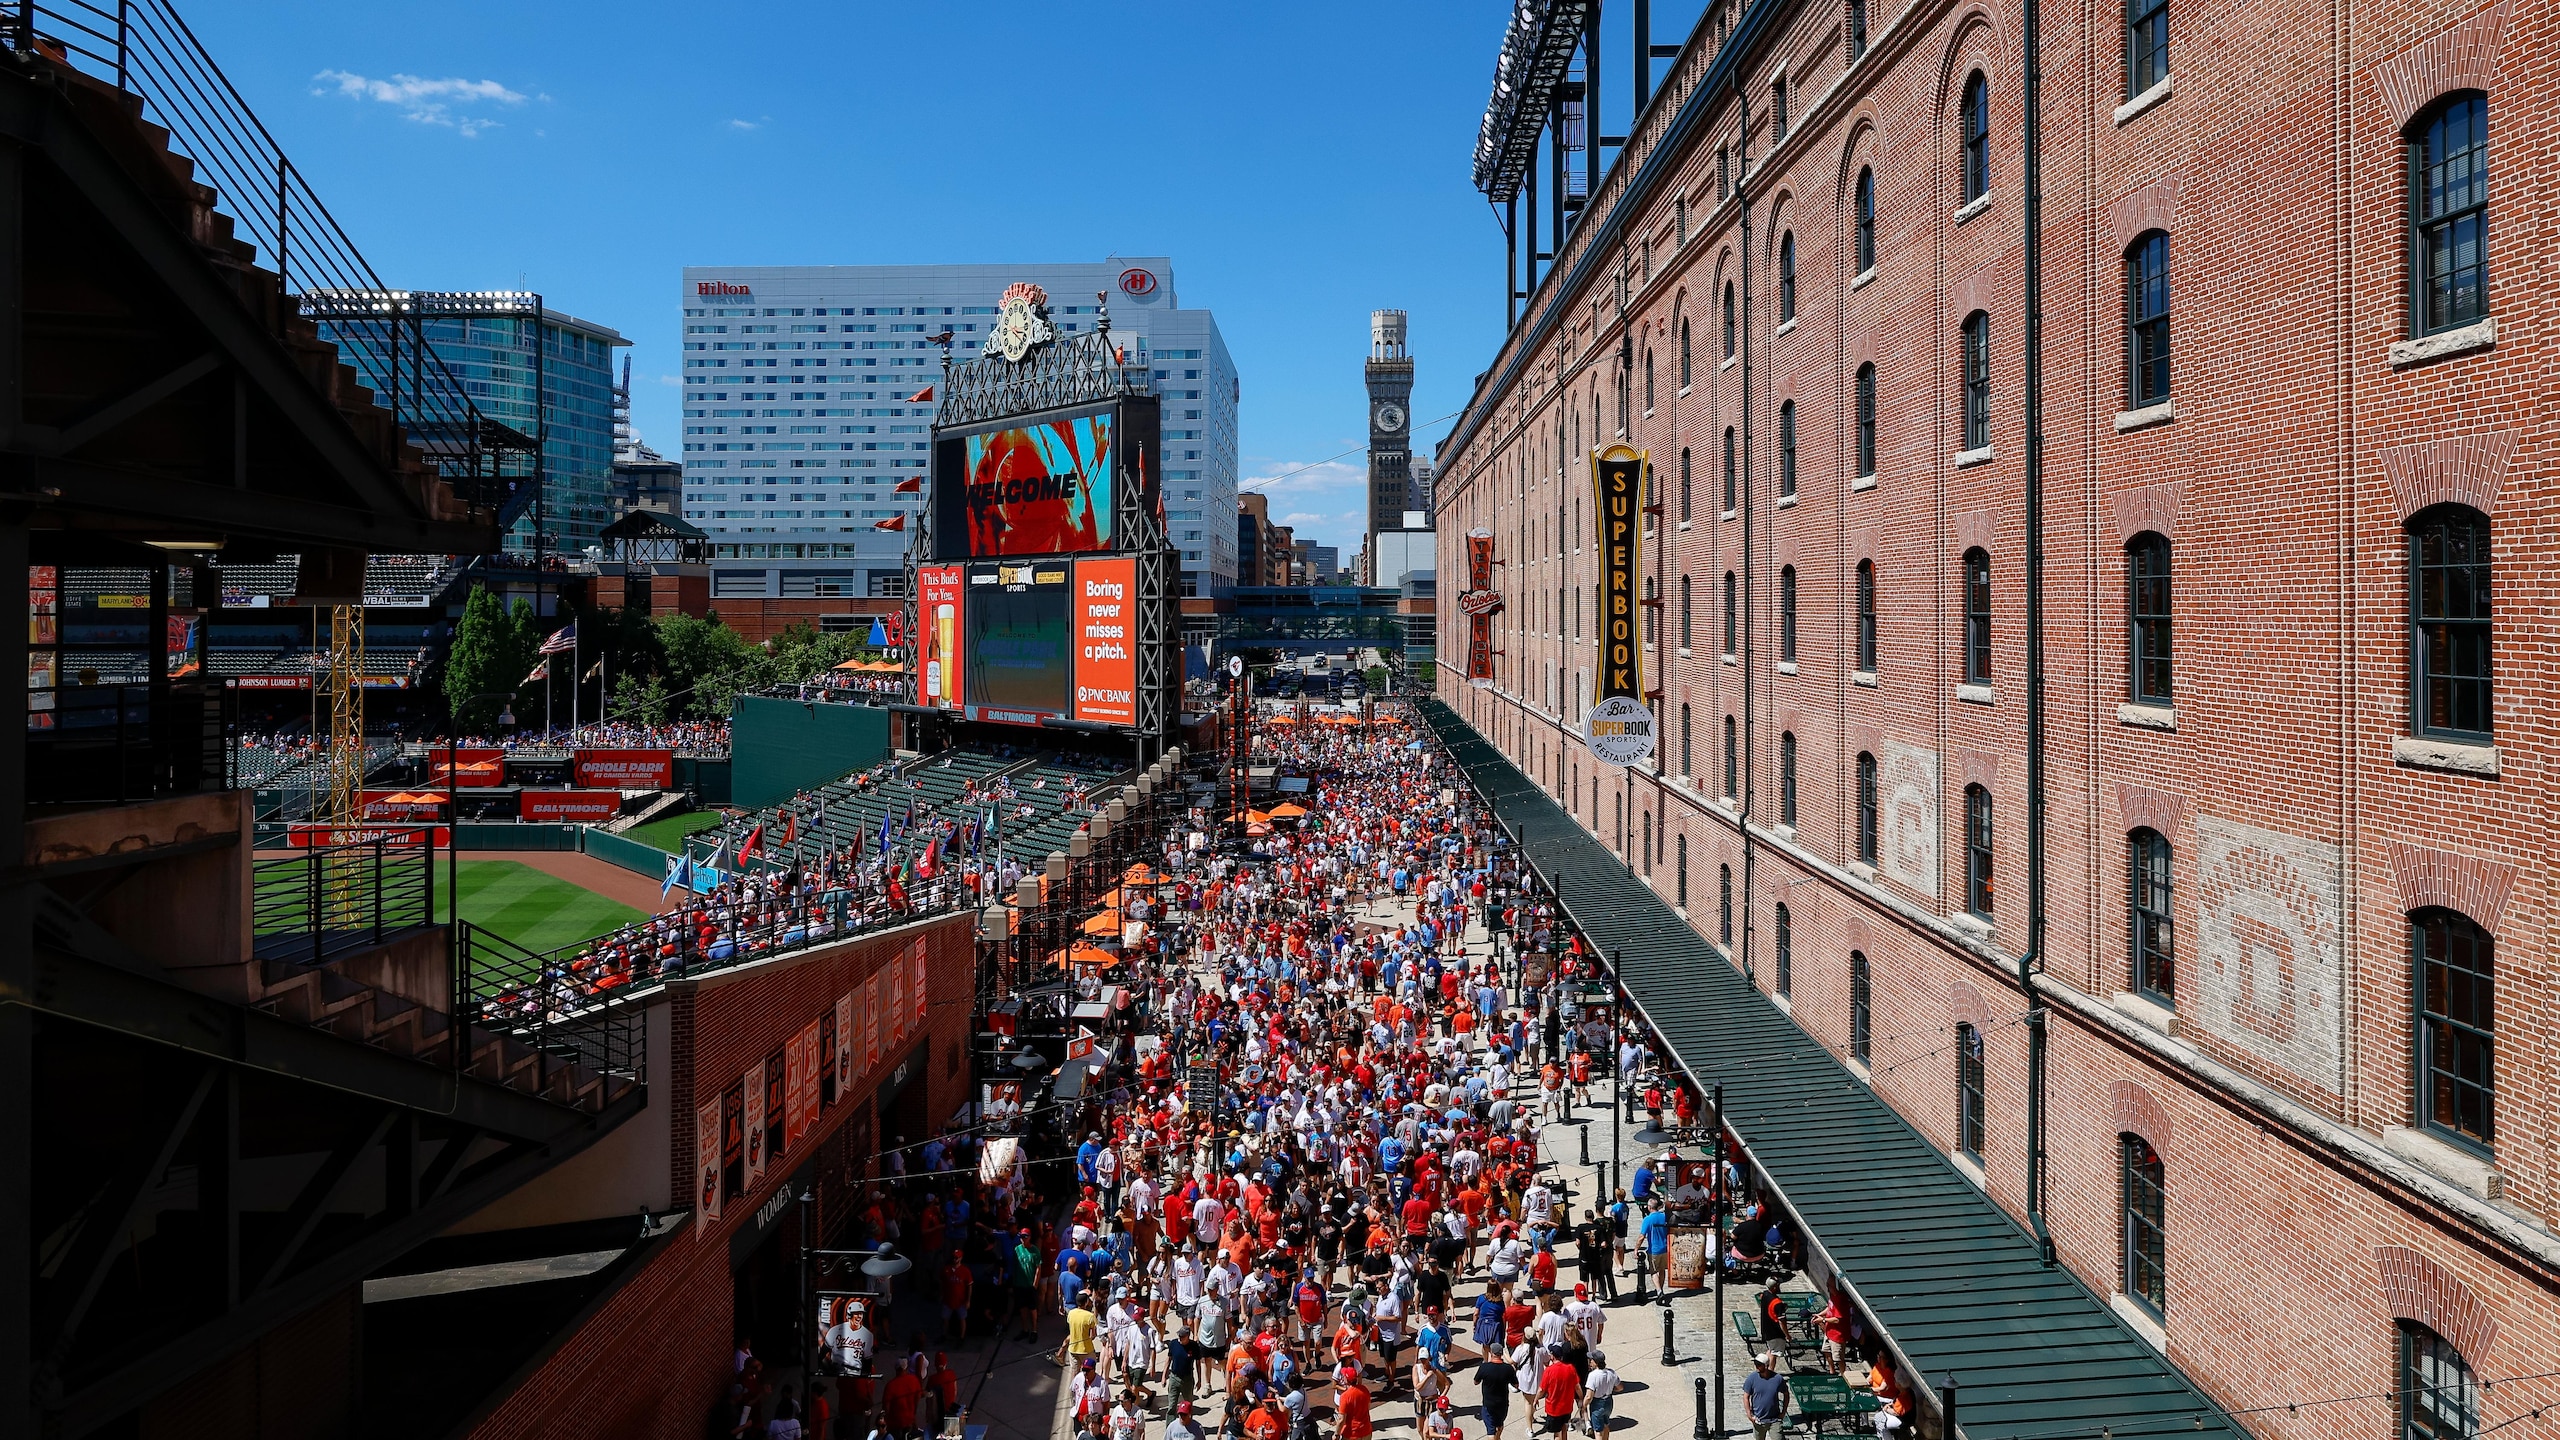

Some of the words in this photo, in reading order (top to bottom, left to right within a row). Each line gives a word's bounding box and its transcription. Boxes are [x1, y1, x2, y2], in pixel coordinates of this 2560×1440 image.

[697, 282, 749, 295] Hilton
[964, 473, 1077, 506] WELCOME
[923, 573, 939, 585] This
[941, 572, 959, 585] Bud's
[1000, 566, 1034, 586] SUPERBOOK
[1612, 471, 1630, 690] SUPERBOOK
[927, 588, 939, 601] For
[940, 588, 955, 601] You.
[1086, 579, 1123, 600] Boring
[1461, 592, 1501, 611] Orioles
[1088, 604, 1120, 617] never
[1085, 622, 1124, 638] misses
[1085, 646, 1093, 658] a
[1095, 642, 1127, 662] pitch.
[239, 677, 268, 686] JOHNSON
[271, 677, 296, 686] LUMBER
[1607, 701, 1635, 716] Bar
[988, 710, 1036, 724] BALTIMORE
[1592, 720, 1651, 737] SUPERBOOK
[1595, 742, 1649, 763] RESTAURANT
[582, 762, 624, 772] ORIOLE
[629, 762, 665, 772] PARK
[533, 804, 609, 813] BALTIMORE
[894, 1060, 907, 1087] MEN
[1394, 1186, 1402, 1198] 5
[757, 1183, 792, 1231] WOMEN
[1538, 1198, 1547, 1210] 2
[1205, 1211, 1214, 1222] 10
[821, 1298, 831, 1324] ADLEY
